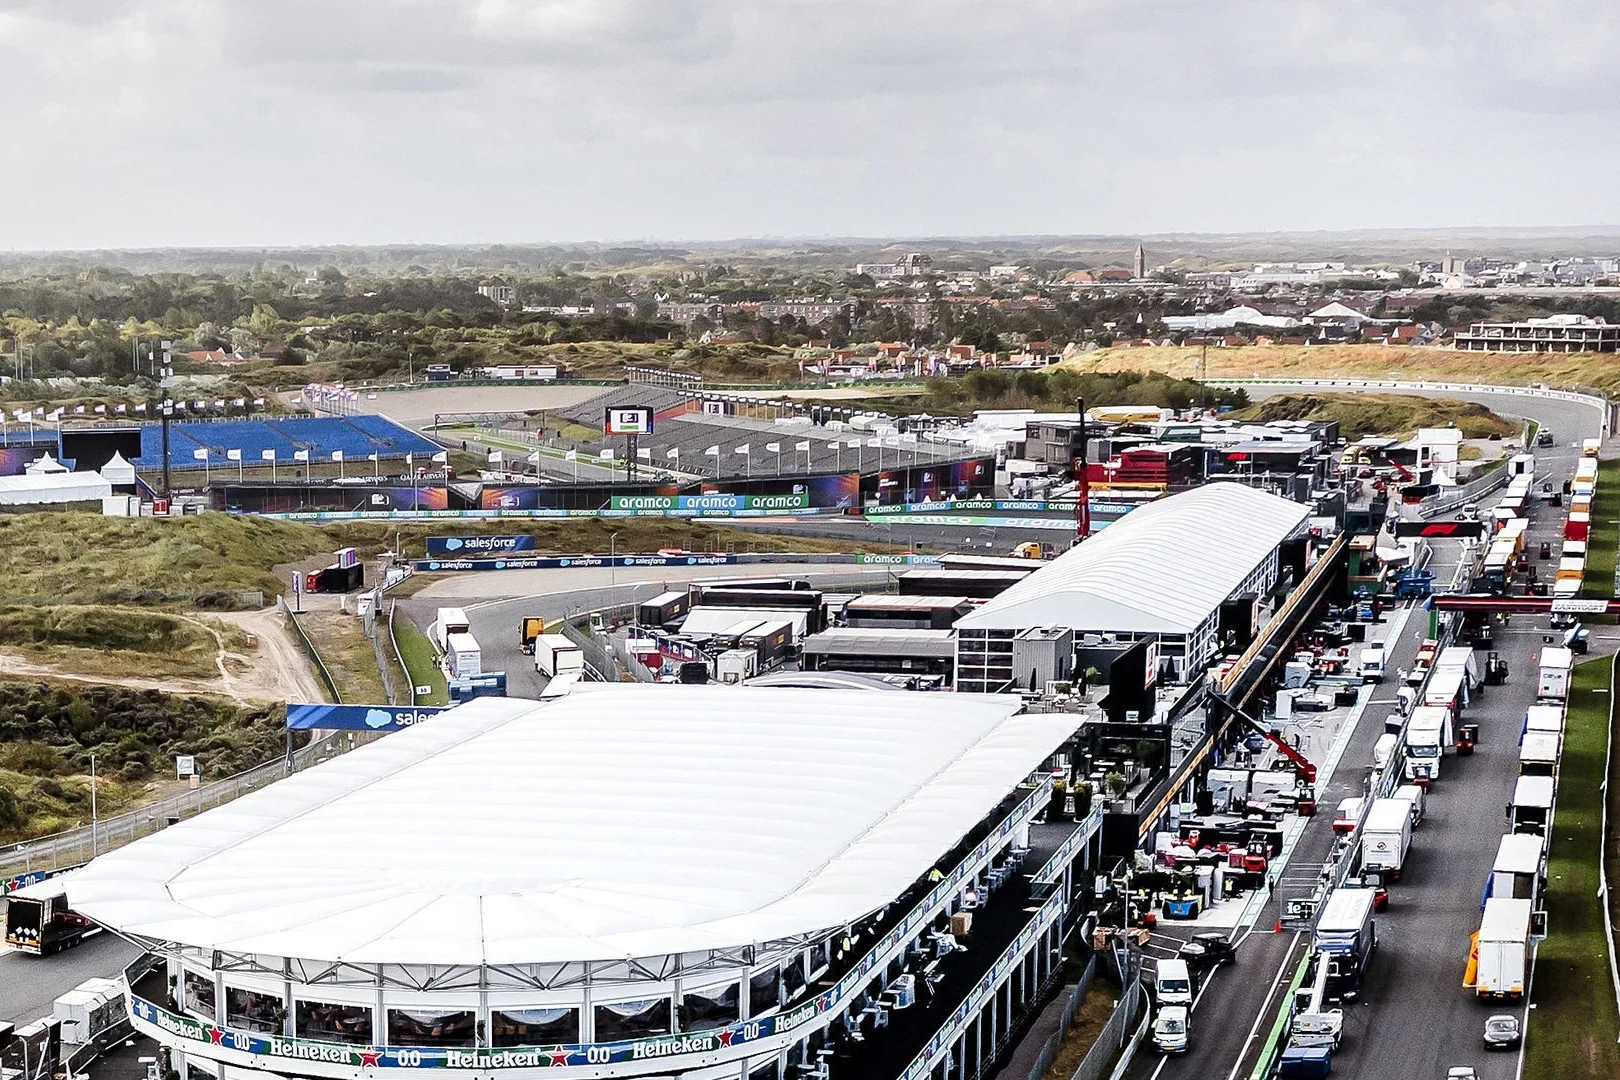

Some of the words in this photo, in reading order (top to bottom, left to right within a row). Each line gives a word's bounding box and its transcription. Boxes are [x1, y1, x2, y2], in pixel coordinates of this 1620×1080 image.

[620, 496, 671, 508] aramco
[687, 496, 737, 508] aramco
[753, 496, 801, 507] aramco
[956, 501, 991, 509] aramco
[1003, 502, 1038, 510] aramco
[869, 505, 901, 514] aramco
[911, 502, 946, 511] aramco
[1094, 505, 1127, 513] aramco
[465, 537, 516, 549] salesforce
[506, 559, 538, 568] salesforce
[571, 558, 602, 567] salesforce
[635, 557, 666, 566] salesforce
[698, 556, 727, 565] salesforce
[864, 555, 902, 563] aramco
[441, 561, 473, 570] salesforce
[156, 1011, 204, 1041] Heineken
[269, 1040, 351, 1064] Heineken
[447, 1051, 539, 1069] Heineken
[632, 1035, 714, 1060] Heineken
[775, 1005, 815, 1033] Heineken
